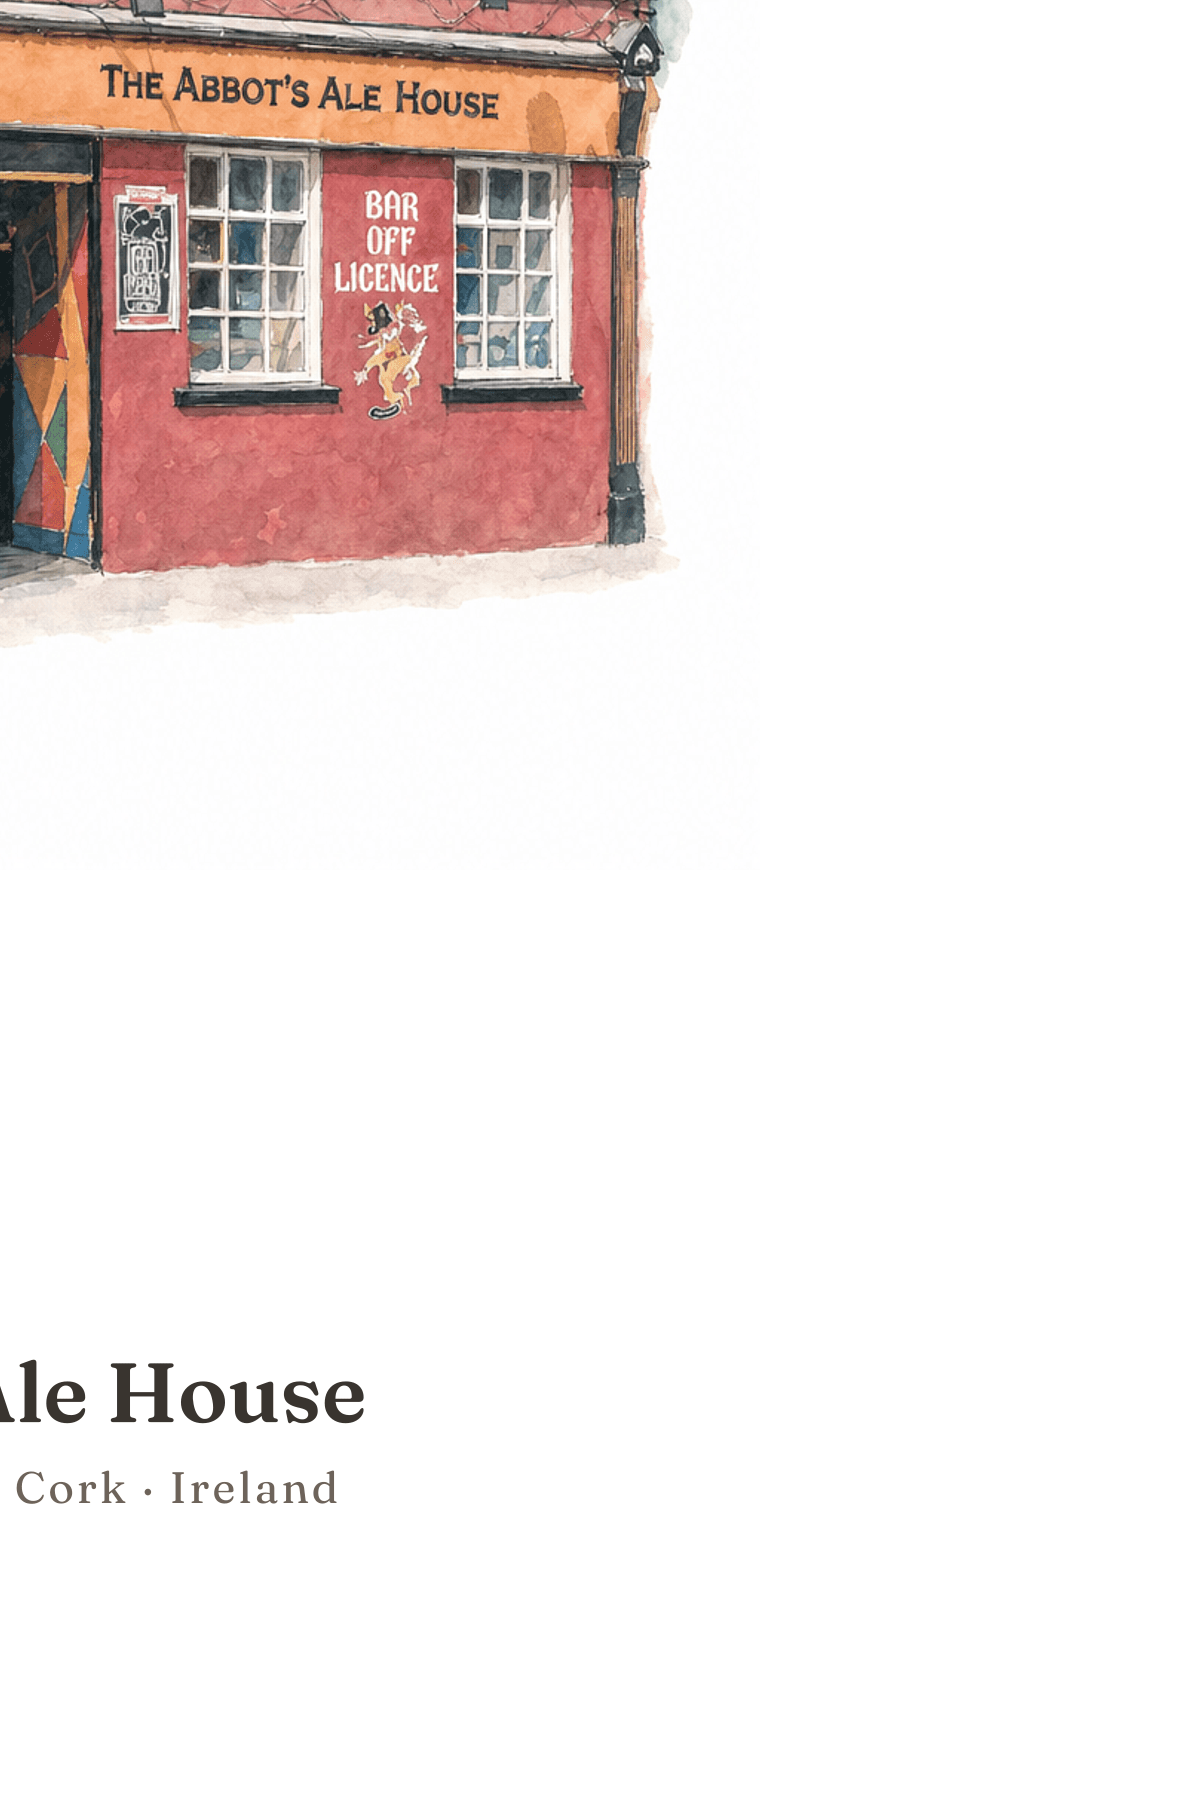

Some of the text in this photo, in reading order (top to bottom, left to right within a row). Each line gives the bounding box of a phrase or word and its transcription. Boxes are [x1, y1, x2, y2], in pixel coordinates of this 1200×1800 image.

[100, 63, 500, 120] THE ABBOT'S ALE HOUSE
[364, 189, 419, 222] BAR
[367, 225, 416, 257] OFF
[334, 261, 440, 294] LICENCE
